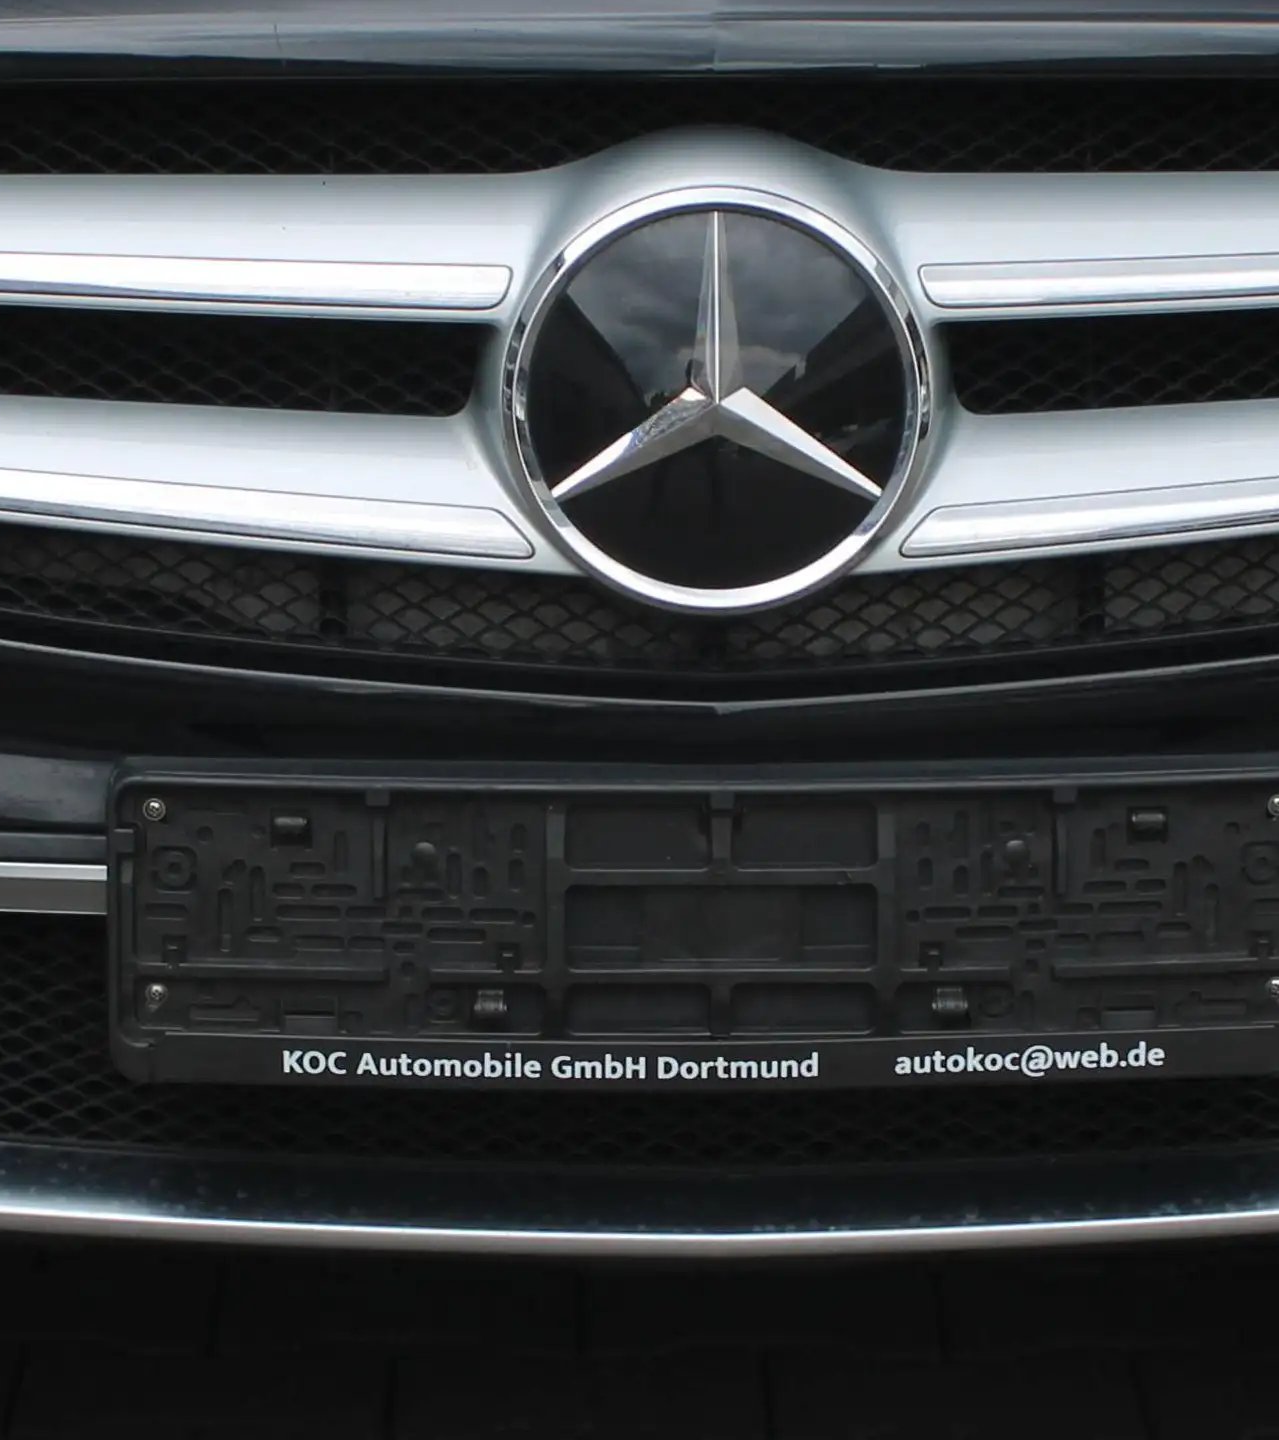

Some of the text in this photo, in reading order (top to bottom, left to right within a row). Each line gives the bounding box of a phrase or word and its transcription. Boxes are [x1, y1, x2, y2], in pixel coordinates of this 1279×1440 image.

[282, 1050, 819, 1080] KOC Automobile GmbH Dortmund
[894, 1040, 1165, 1078] autokoc@web.de
